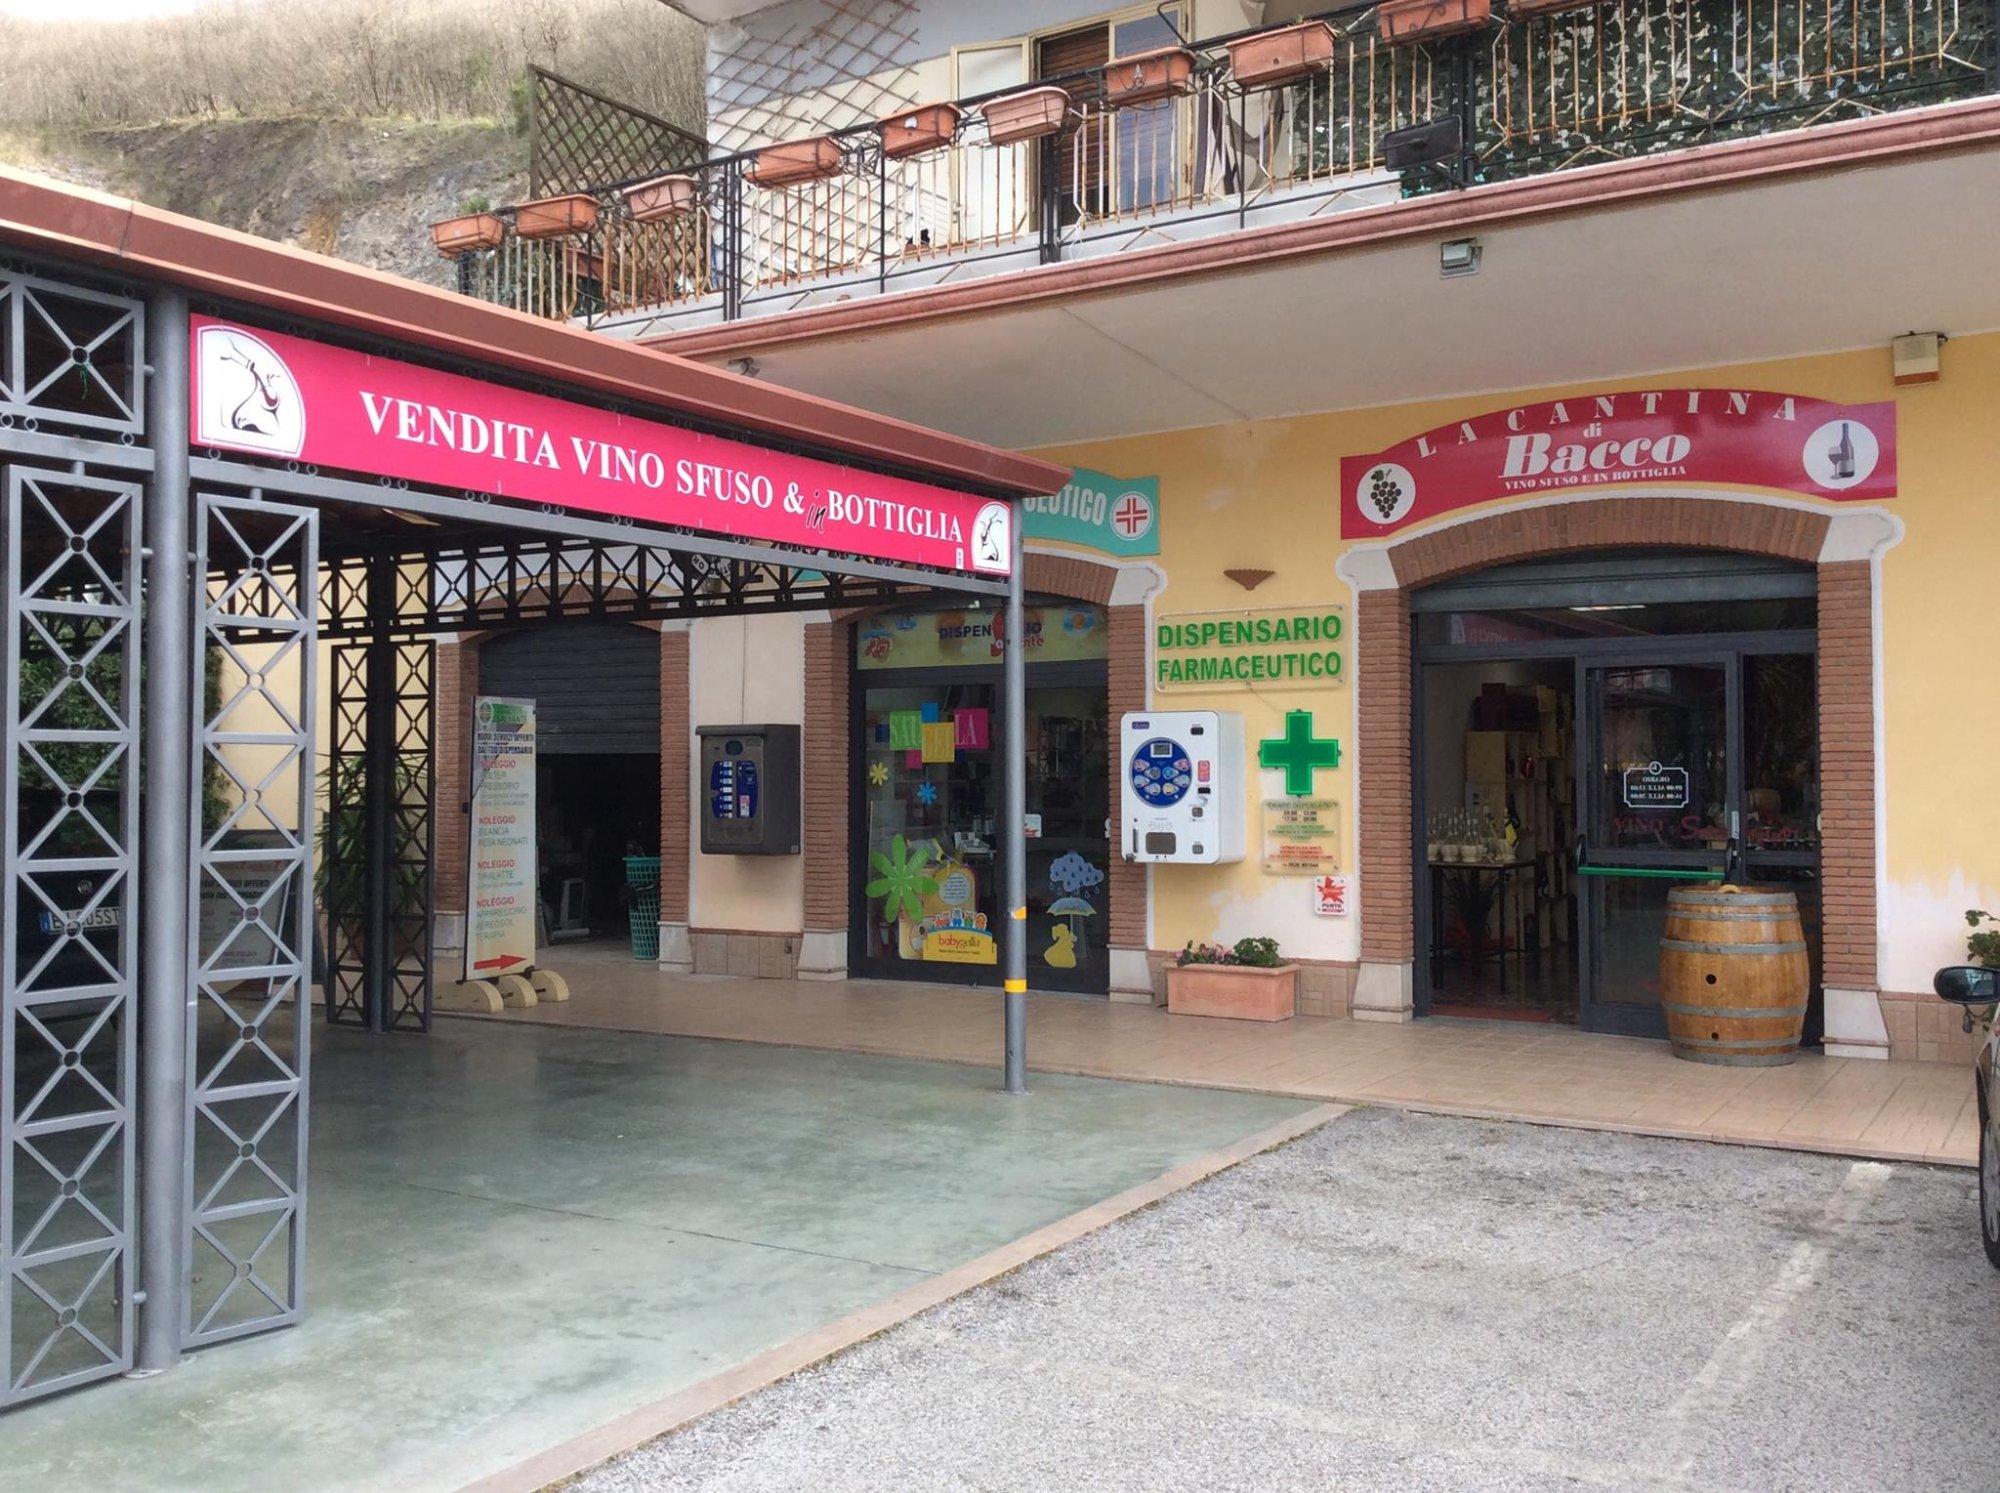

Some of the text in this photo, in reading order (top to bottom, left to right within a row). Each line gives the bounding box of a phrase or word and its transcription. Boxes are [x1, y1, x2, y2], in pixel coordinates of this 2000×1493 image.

[1416, 391, 1797, 459] LA CANTINA
[1582, 422, 1602, 438] di
[359, 390, 561, 470] VENDITA
[570, 434, 666, 489] VINO
[676, 459, 774, 509] SFUSO
[783, 482, 804, 514] &
[828, 489, 963, 543] BOTTIGLIA
[1498, 432, 1691, 478] Bacco
[1505, 465, 1687, 490] VINO SFUSO E IN BOTTIGLIA
[1158, 614, 1342, 649] DISPENSARIO
[1158, 651, 1342, 682] FARMACEUTICO
